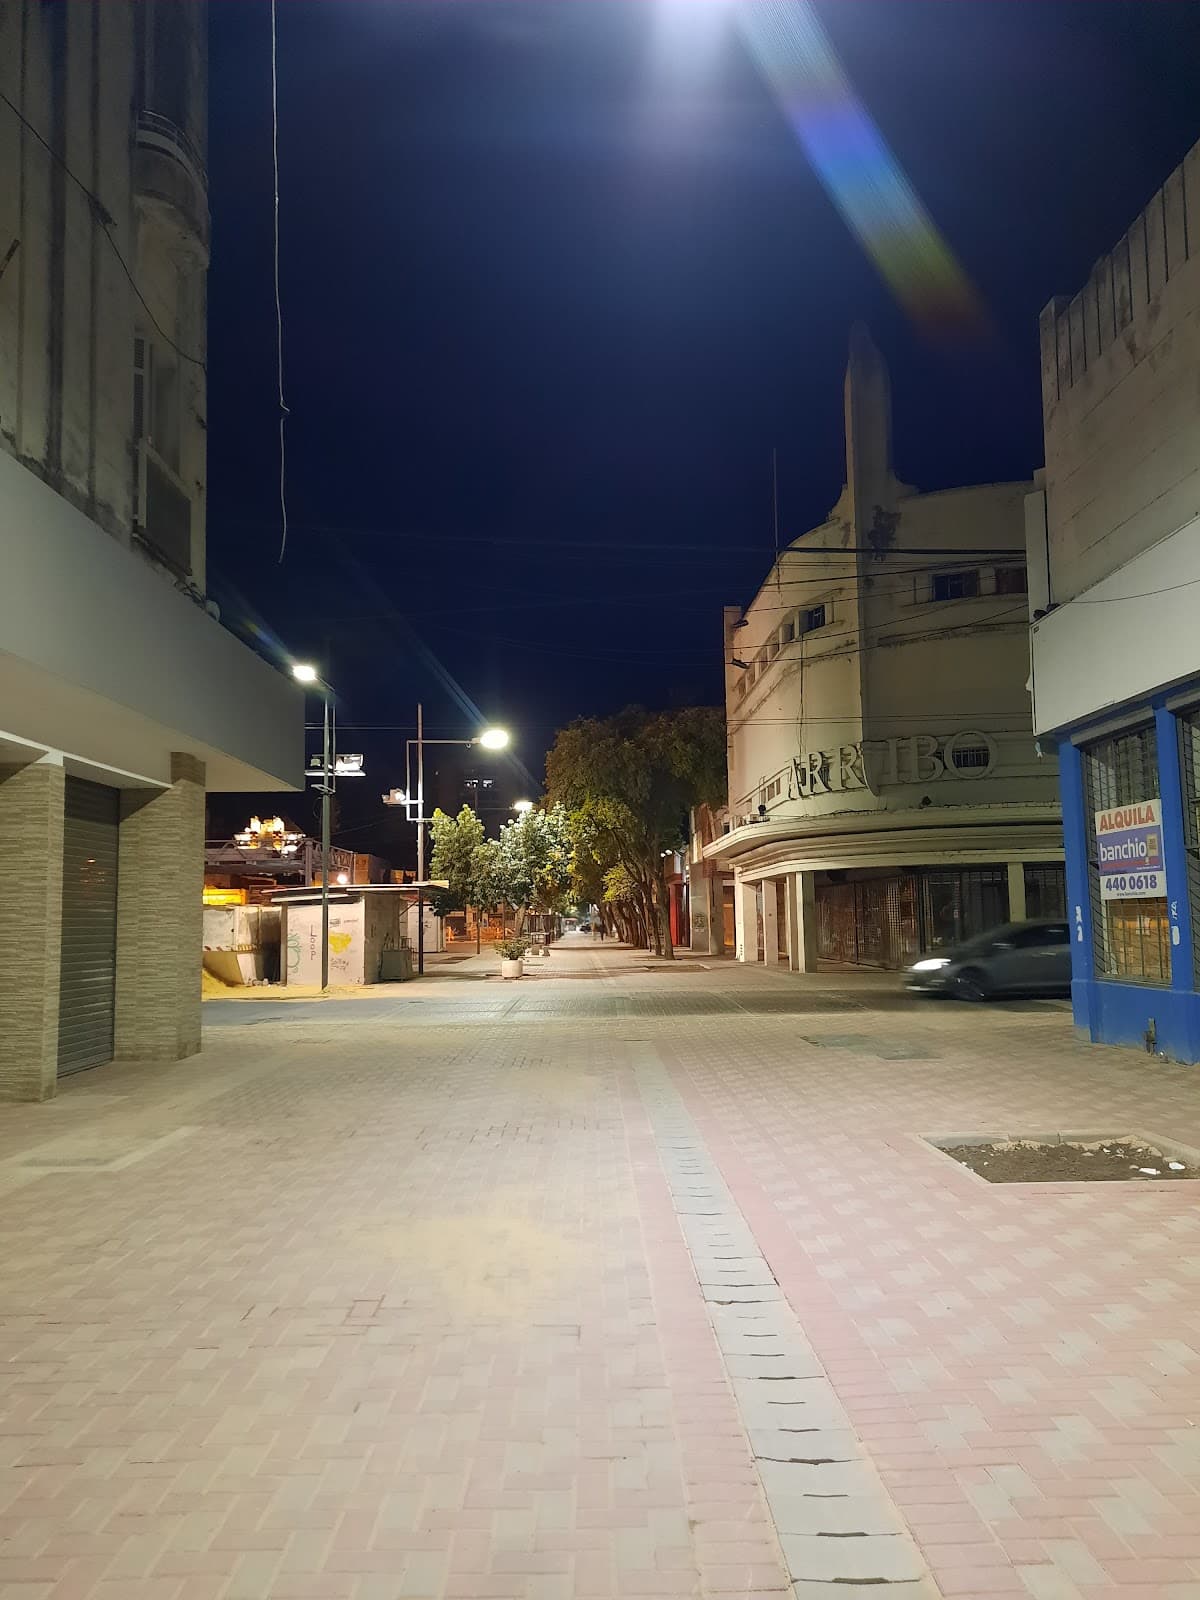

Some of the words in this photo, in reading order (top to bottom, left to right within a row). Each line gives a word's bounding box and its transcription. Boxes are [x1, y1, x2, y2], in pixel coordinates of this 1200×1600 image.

[1100, 805, 1155, 831] ALQUILA
[1100, 838, 1147, 861] banchio
[1106, 876, 1126, 891] 440
[1129, 875, 1157, 890] 0618
